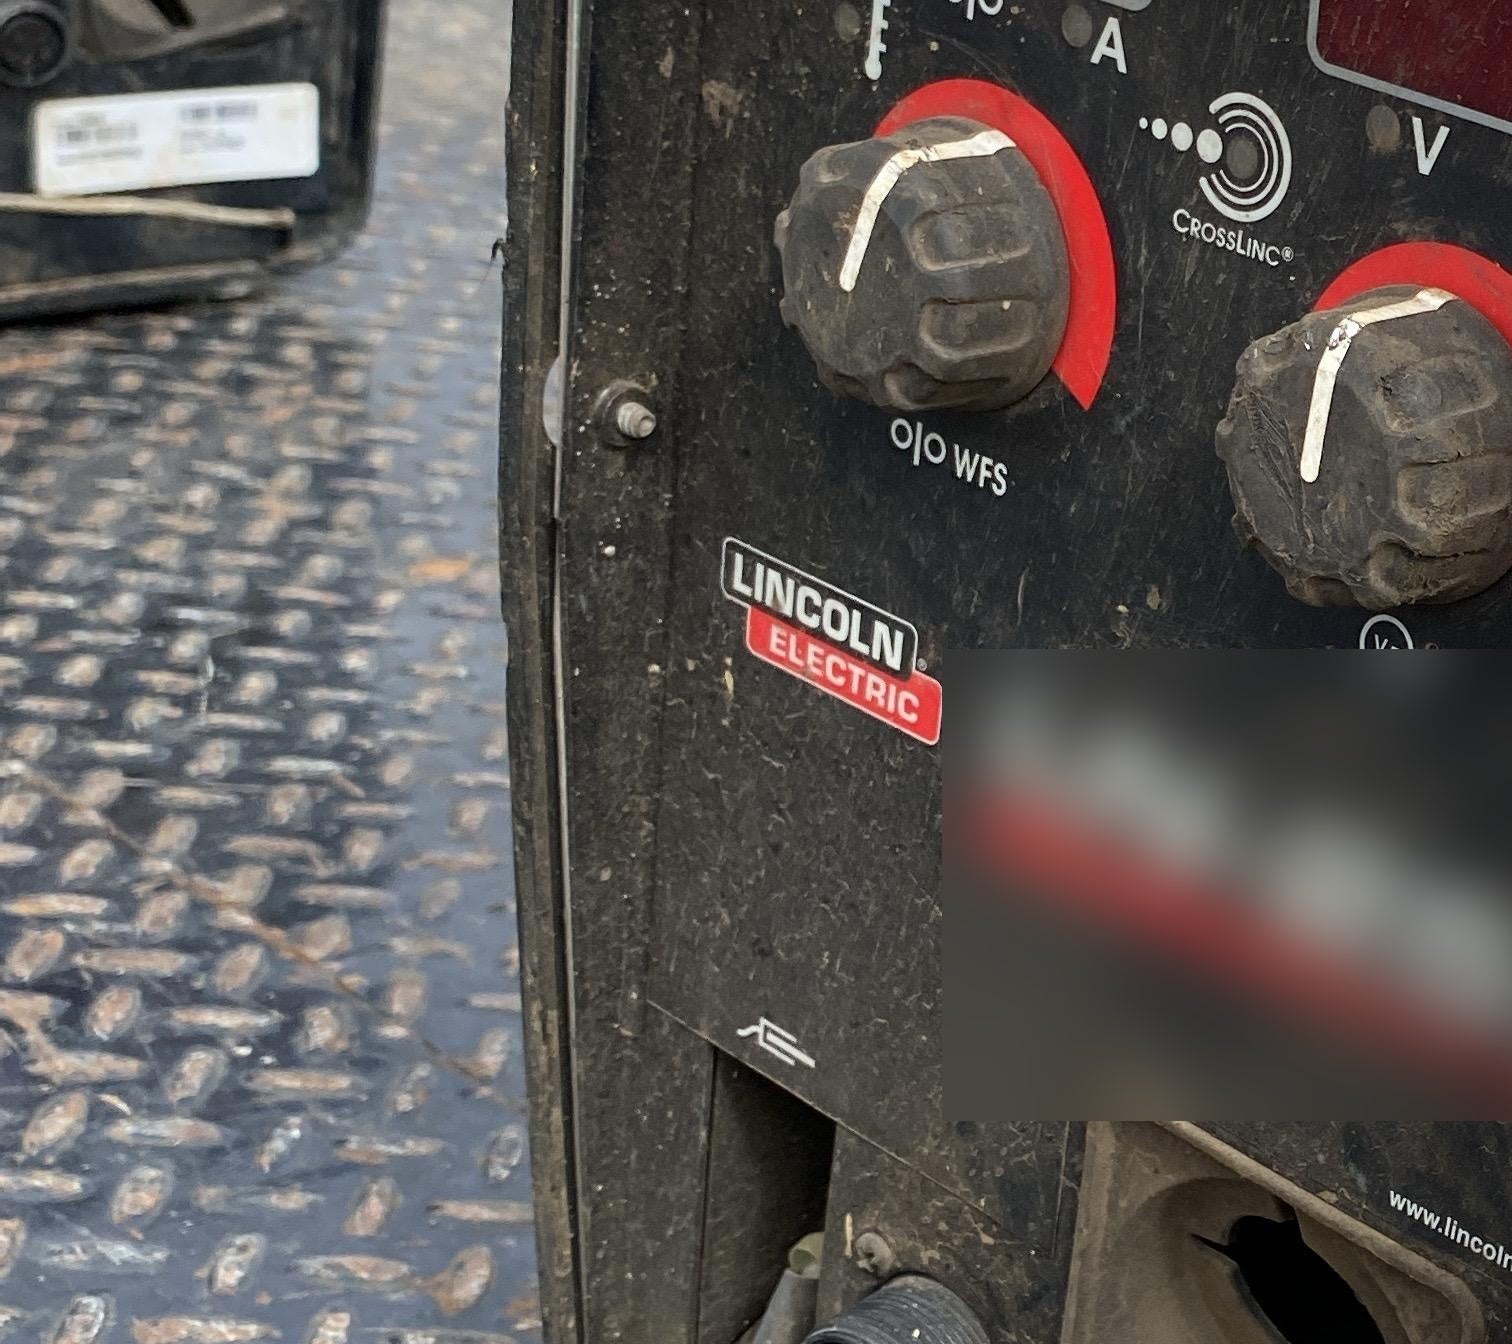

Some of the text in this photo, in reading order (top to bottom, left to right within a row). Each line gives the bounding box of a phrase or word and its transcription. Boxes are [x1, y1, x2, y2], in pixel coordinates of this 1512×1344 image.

[1090, 17, 1127, 74] A
[1412, 116, 1450, 176] V
[953, 443, 1009, 496] WFS
[732, 552, 905, 672] LINCOLN
[768, 623, 919, 724] ELECTRIC
